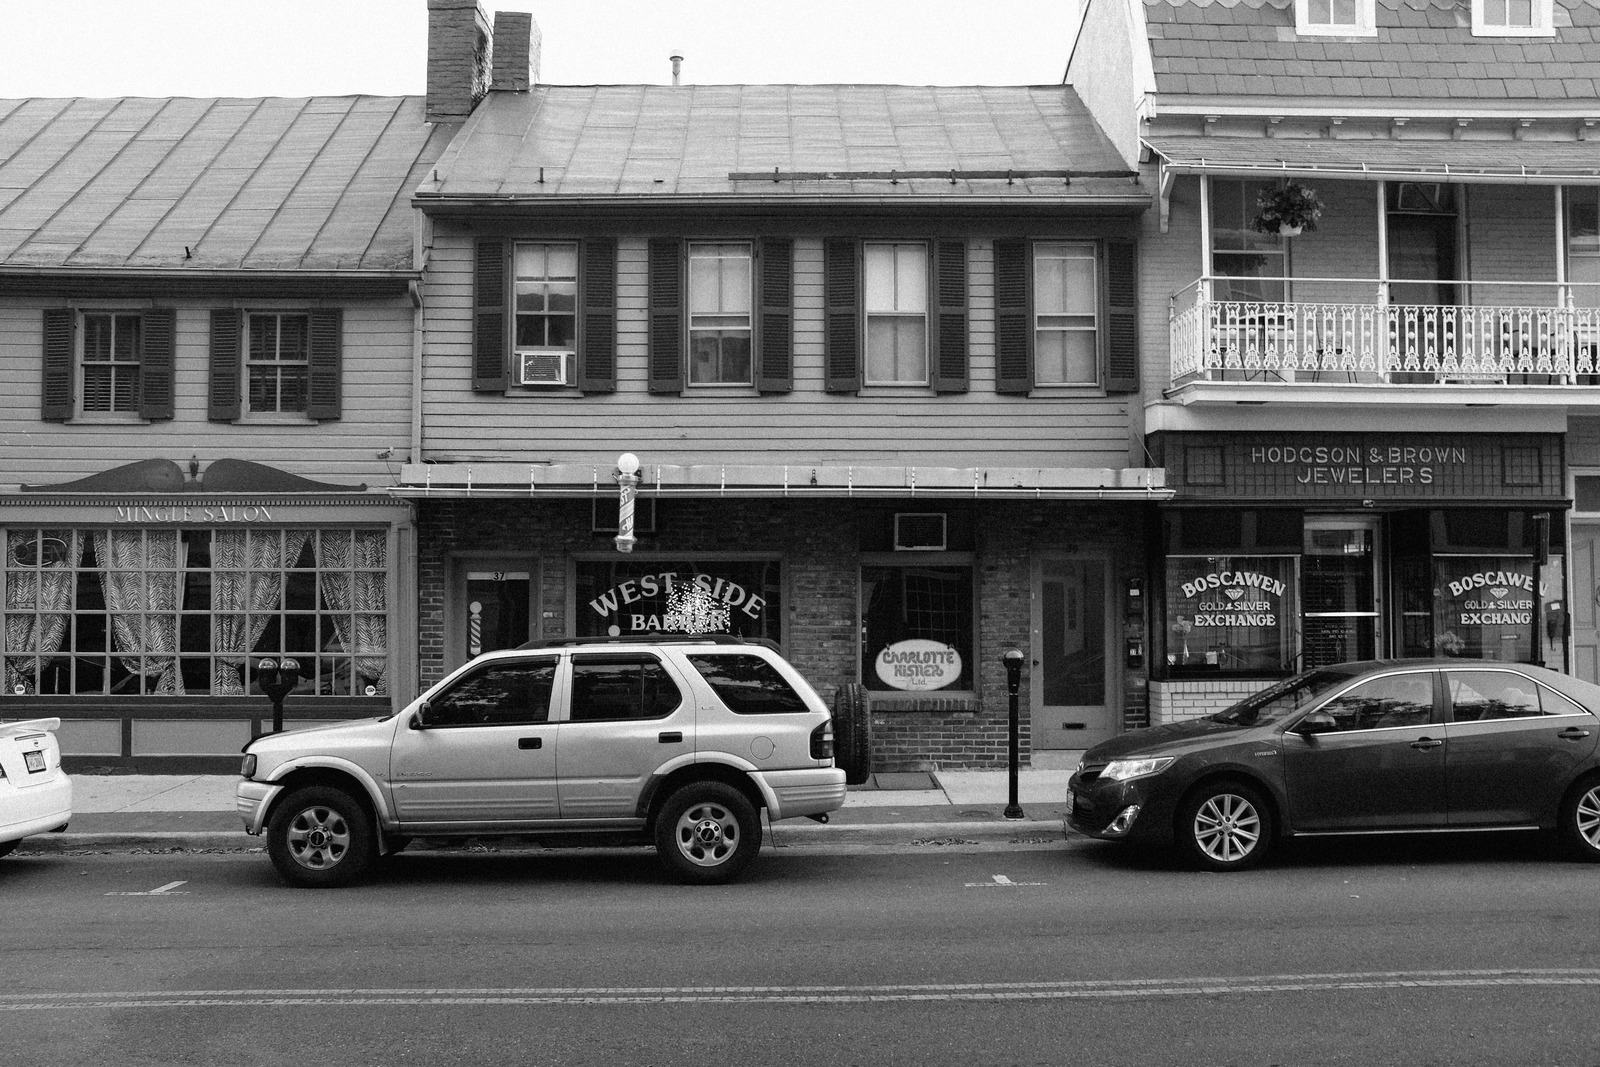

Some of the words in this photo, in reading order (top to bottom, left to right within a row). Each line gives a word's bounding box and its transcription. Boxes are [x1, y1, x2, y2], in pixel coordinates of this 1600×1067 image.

[1252, 447, 1360, 464] HODGSON
[1369, 447, 1384, 464] &
[1388, 447, 1466, 464] BROWN
[1297, 467, 1433, 484] JEWELERS
[115, 506, 194, 522] MINGLE
[203, 506, 272, 522] SALON
[493, 572, 505, 580] 37
[1181, 571, 1286, 599] BOSCAWEN
[589, 572, 677, 618] WEST
[695, 574, 767, 620] SIDE
[1199, 602, 1225, 611] GOLD
[1234, 601, 1271, 611] SILVER
[1464, 600, 1488, 610] GOLD
[1497, 600, 1533, 610] SILVER
[1194, 614, 1276, 627] EXCHANGE
[1460, 613, 1532, 625] EXCHANG
